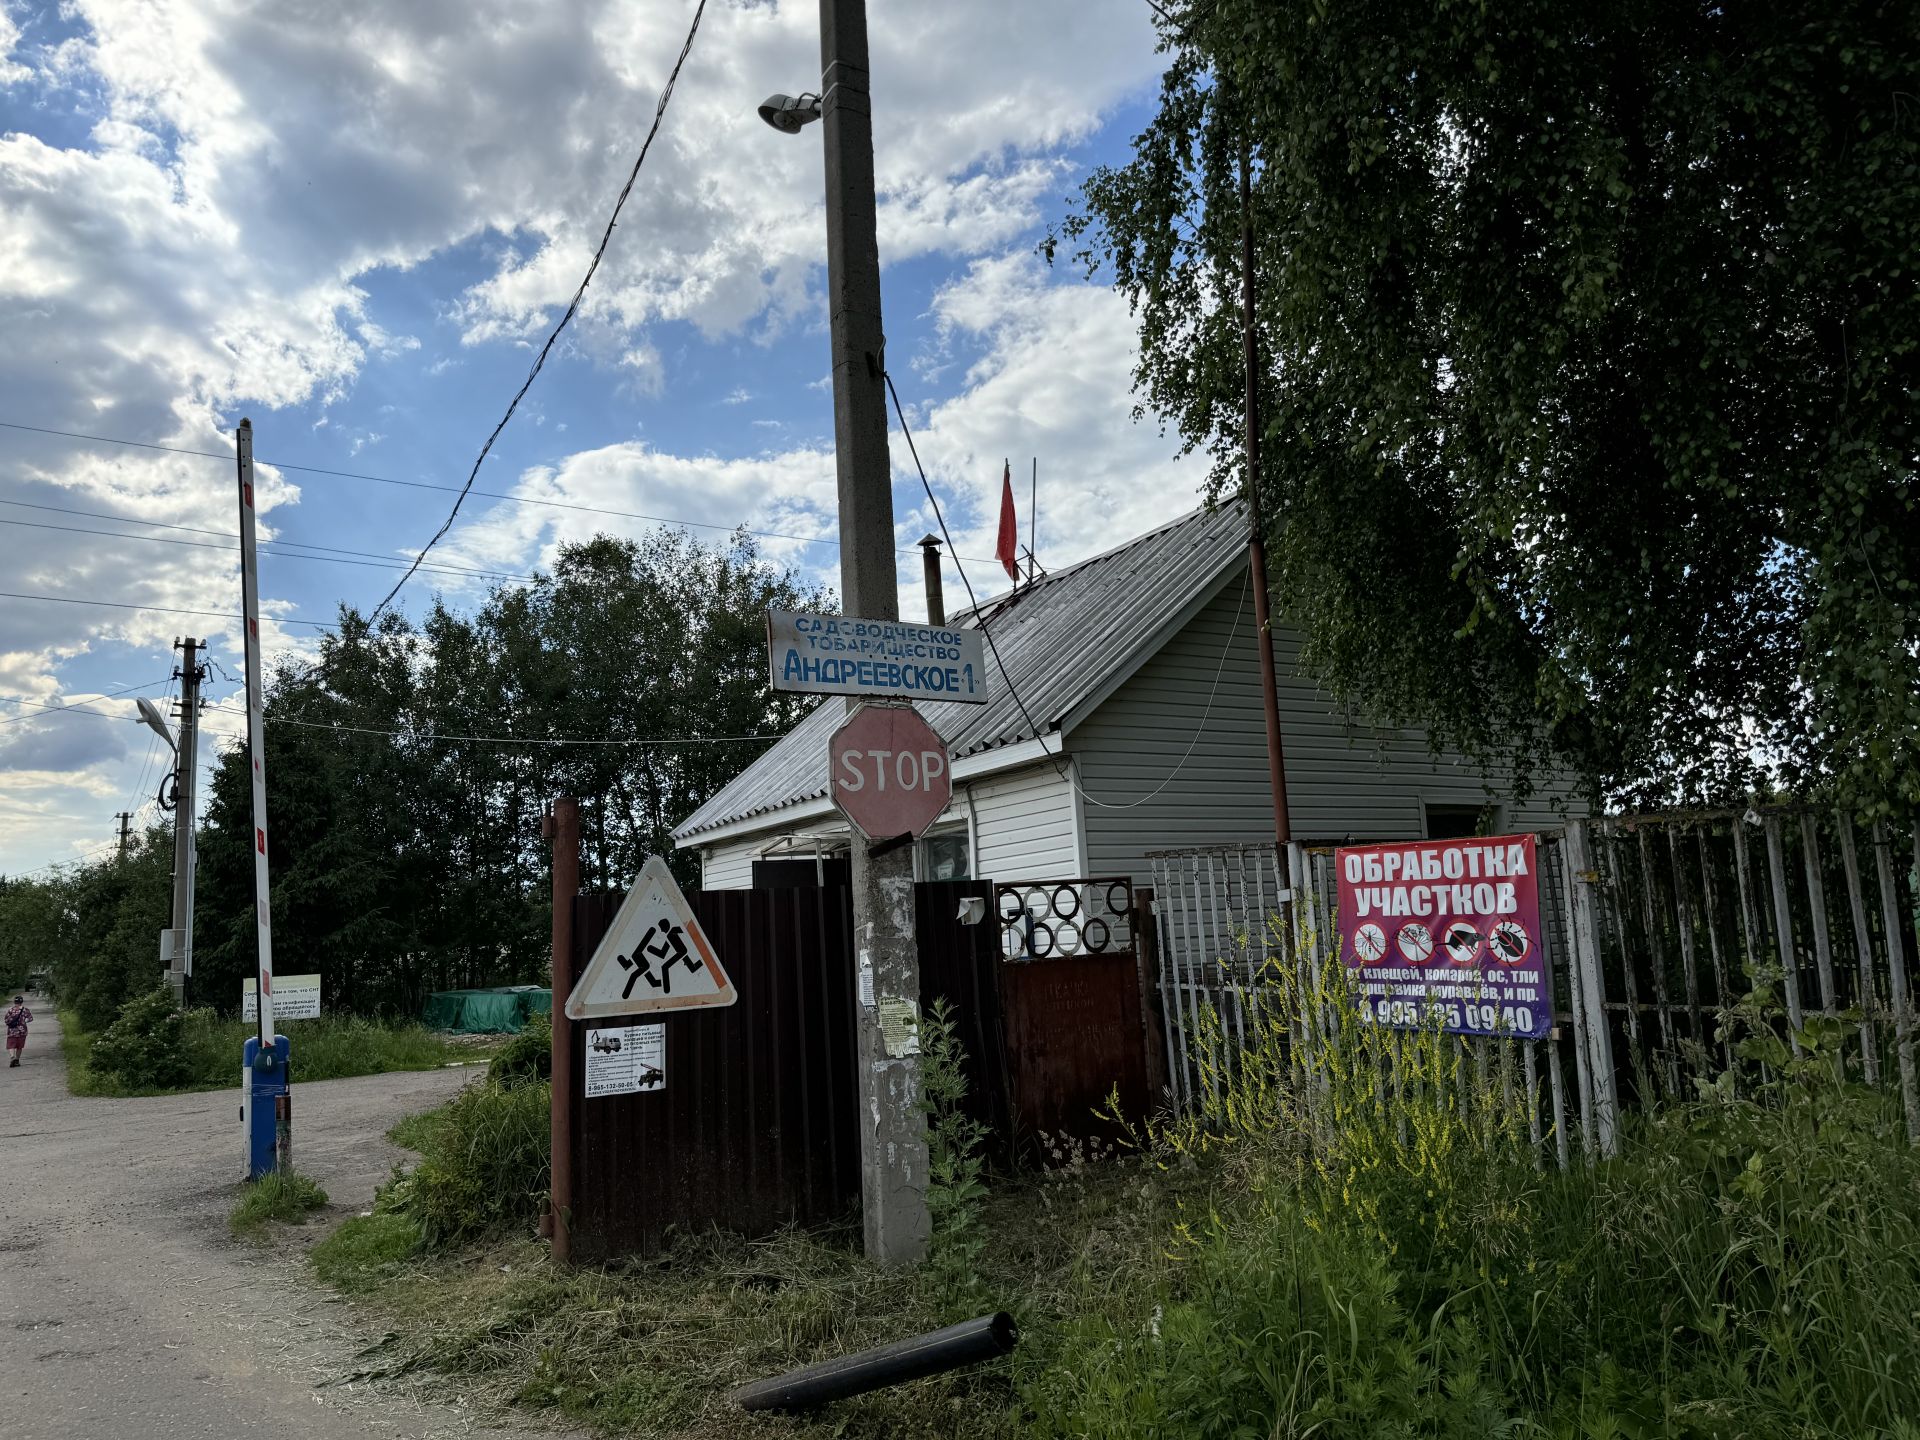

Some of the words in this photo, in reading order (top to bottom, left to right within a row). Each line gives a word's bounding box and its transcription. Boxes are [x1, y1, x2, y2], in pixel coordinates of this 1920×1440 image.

[795, 617, 962, 646] САДОВОДЧЕСКОЕ
[838, 749, 945, 792] STOP
[1344, 844, 1529, 884] ОБРАБОТКА
[1354, 882, 1518, 917] УЧАСТКОВ
[1363, 965, 1424, 982] клещей,
[1424, 968, 1485, 984] комаров,
[1487, 969, 1509, 985] ос,
[1510, 970, 1539, 984] тли
[1503, 987, 1514, 1001] и
[1516, 987, 1540, 1003] пр.
[1465, 1004, 1496, 1031] 09
[1501, 1006, 1533, 1033] 40
